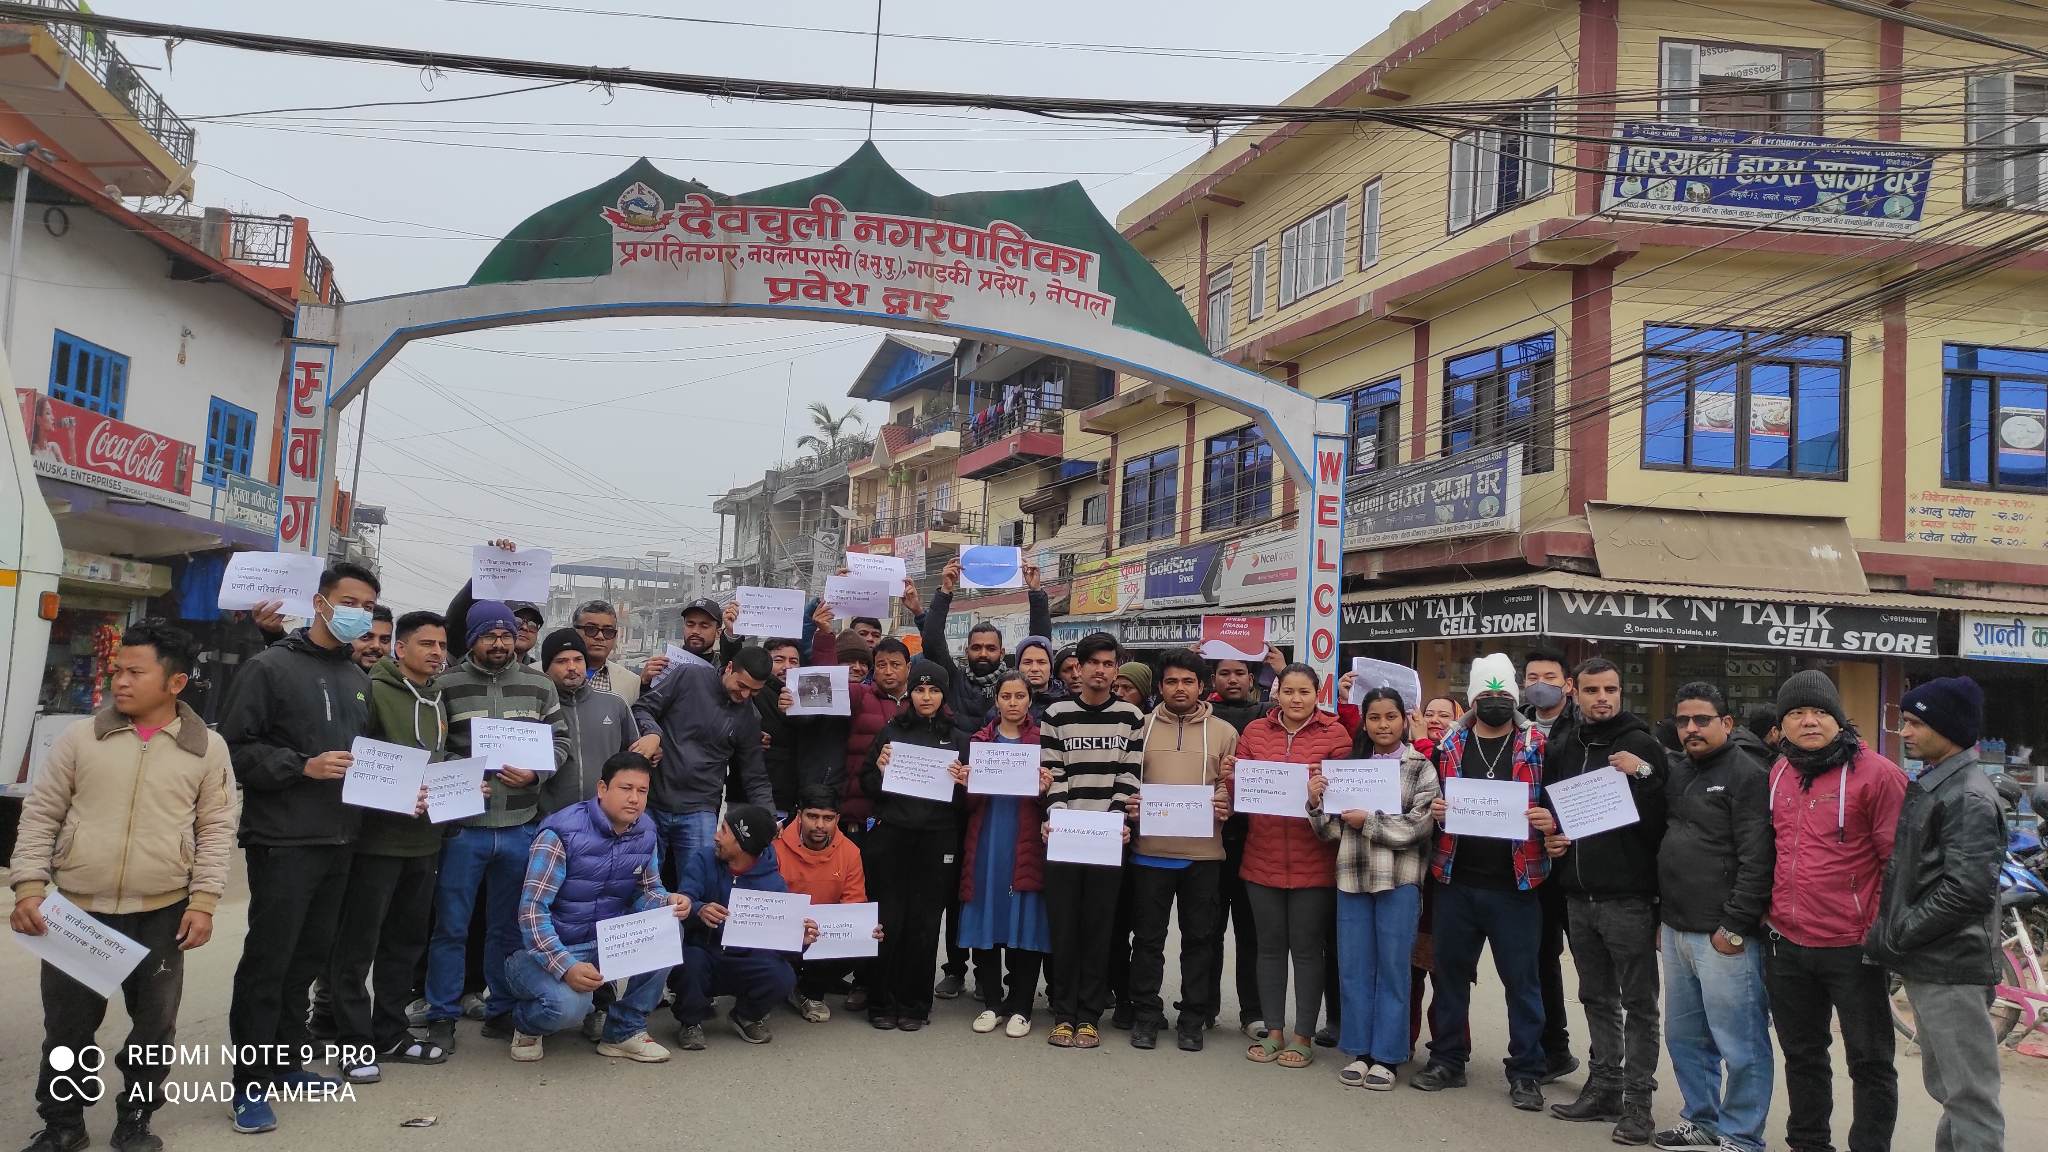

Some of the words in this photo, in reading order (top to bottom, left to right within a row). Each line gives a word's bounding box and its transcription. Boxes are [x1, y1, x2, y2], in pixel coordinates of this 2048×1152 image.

[678, 194, 847, 244] देवचुली
[853, 216, 1095, 282] नगरपालिका
[616, 234, 745, 271] प्रगतिनगर,
[1046, 278, 1112, 319] नेपाल
[764, 270, 871, 307] प्रवेश
[882, 286, 954, 320] द्वार
[70, 470, 122, 491] ENTERPRISES
[1342, 603, 1392, 625] WALK
[1423, 595, 1477, 619] TALK
[1440, 617, 1477, 636] CELL
[1481, 612, 1537, 634] STORE
[1558, 591, 1675, 620] WALK
[1735, 602, 1834, 629] TALK
[1767, 626, 1834, 648] CELL
[1841, 631, 1934, 654] STORE
[605, 932, 628, 942] official
